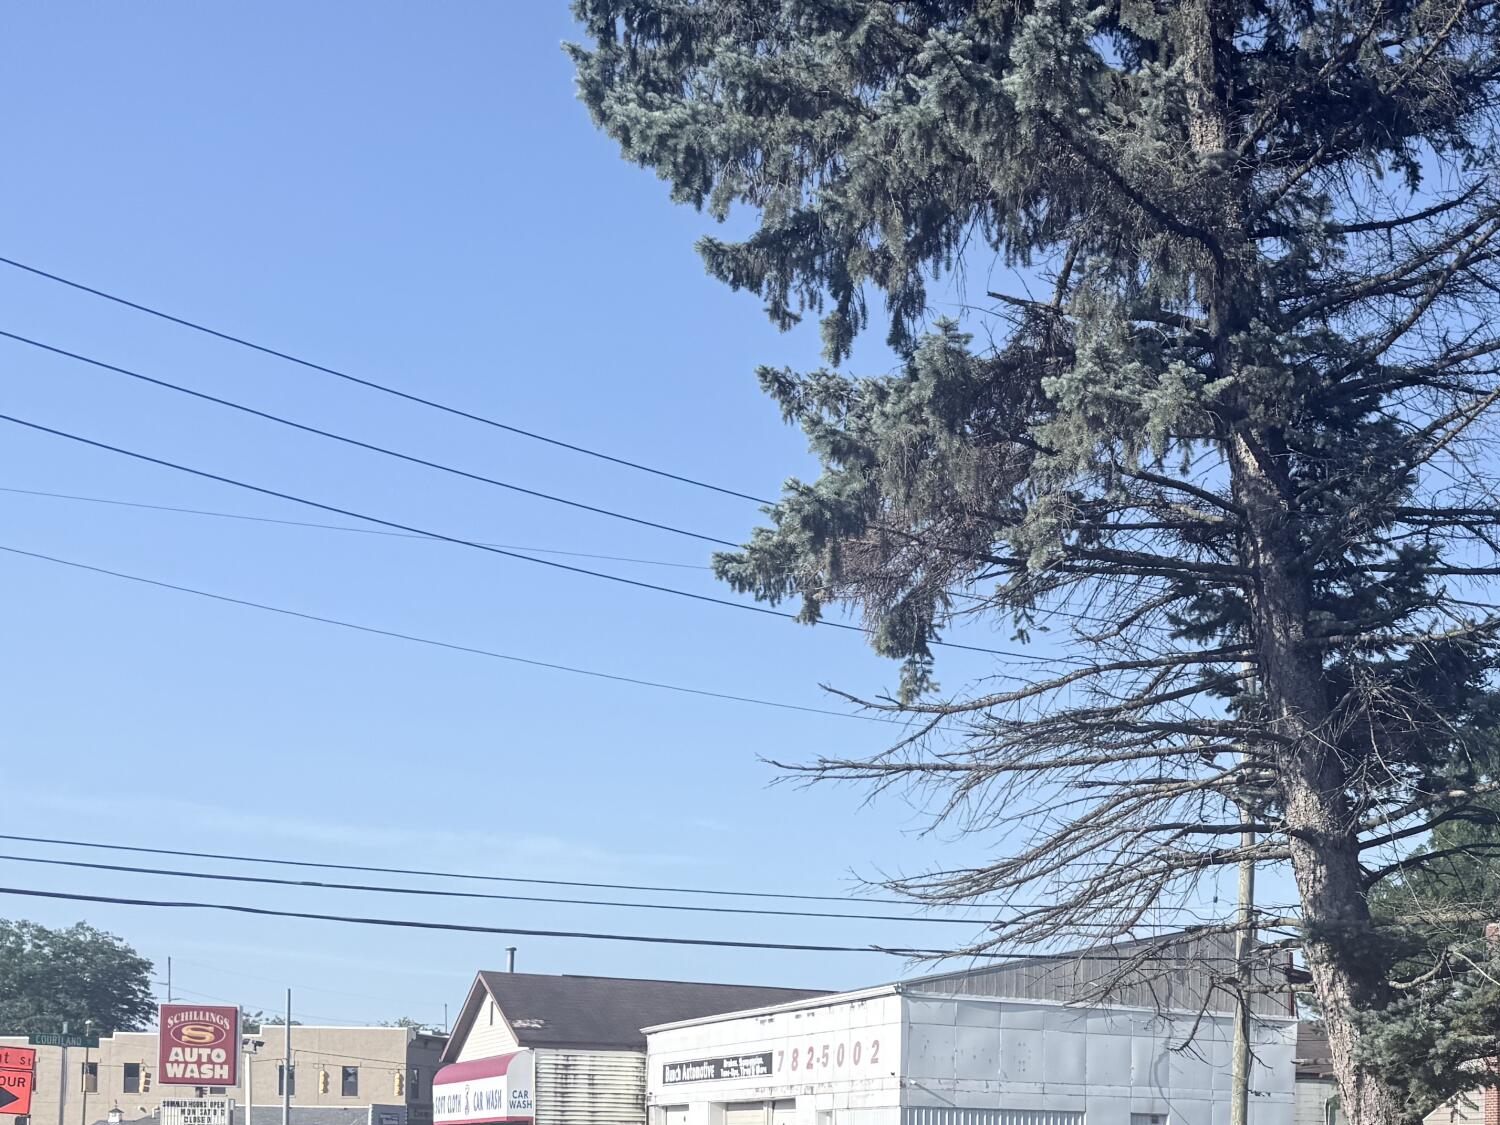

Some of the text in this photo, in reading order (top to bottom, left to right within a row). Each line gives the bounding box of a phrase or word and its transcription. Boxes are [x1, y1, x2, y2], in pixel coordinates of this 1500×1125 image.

[168, 1010, 230, 1030] SCHILLINGS
[181, 1025, 215, 1043] S
[169, 1047, 227, 1063] AUTO
[166, 1063, 229, 1079] WASH
[447, 1094, 462, 1114] CLOTH
[473, 1090, 483, 1112] CAR
[485, 1089, 502, 1111] WASH
[512, 1090, 529, 1099] CAR
[509, 1100, 533, 1109] WASH
